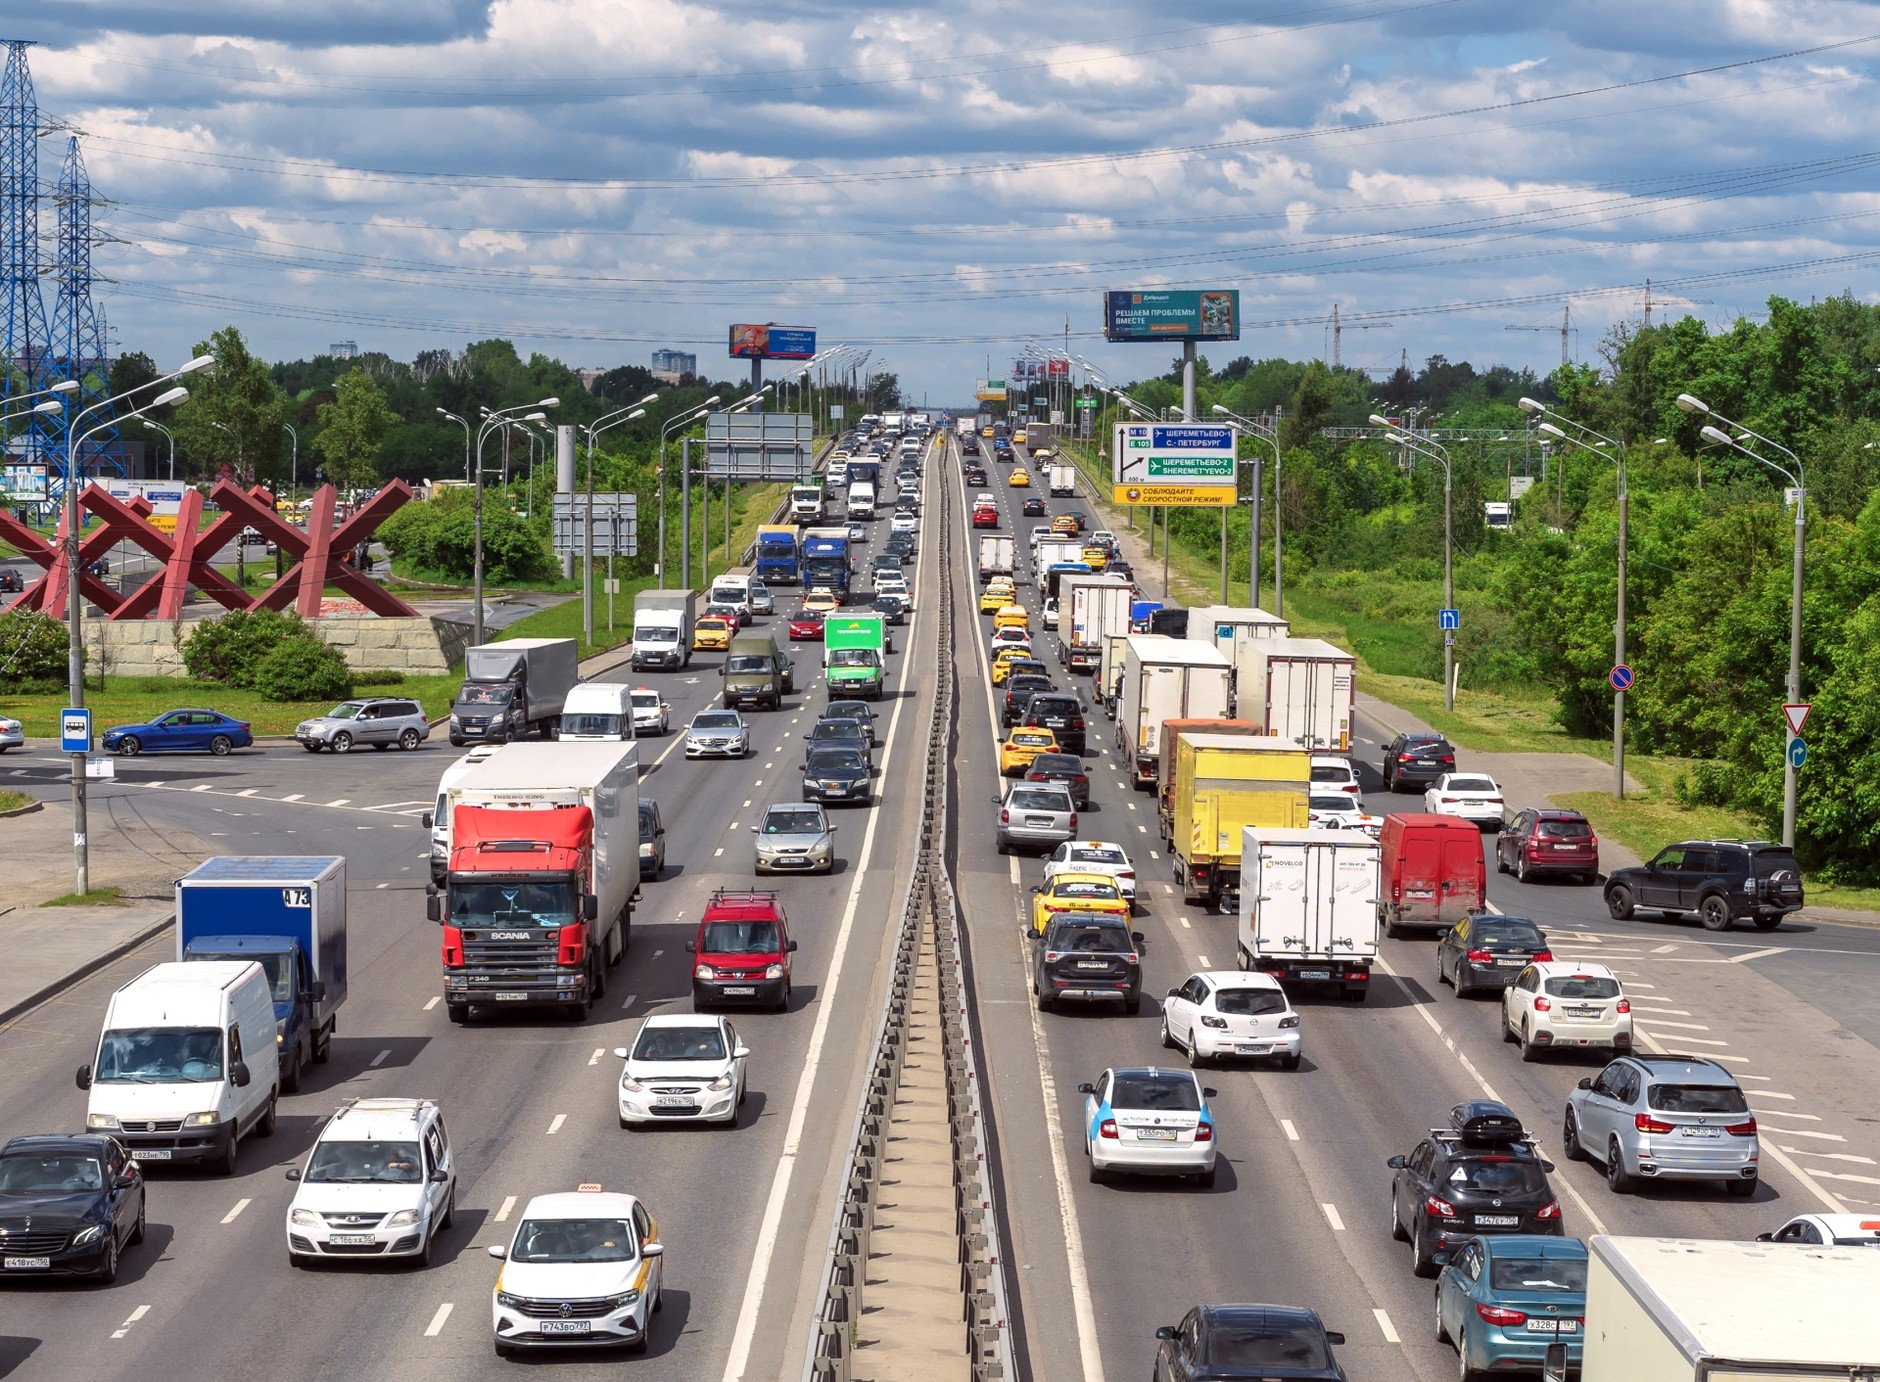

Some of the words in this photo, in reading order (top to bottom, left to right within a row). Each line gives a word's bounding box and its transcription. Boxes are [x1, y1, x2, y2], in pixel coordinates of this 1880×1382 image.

[1115, 309, 1150, 317] РЕШАЕМ
[1151, 308, 1196, 316] ПРОБЛЕМЫ
[1115, 317, 1146, 325] ВМЕСТЕ
[1177, 439, 1222, 447] ПЕТЕРБУРГ
[1142, 495, 1193, 503] СКОРОСТНОЙ
[294, 890, 310, 906] 73
[491, 932, 531, 940] SCANIA
